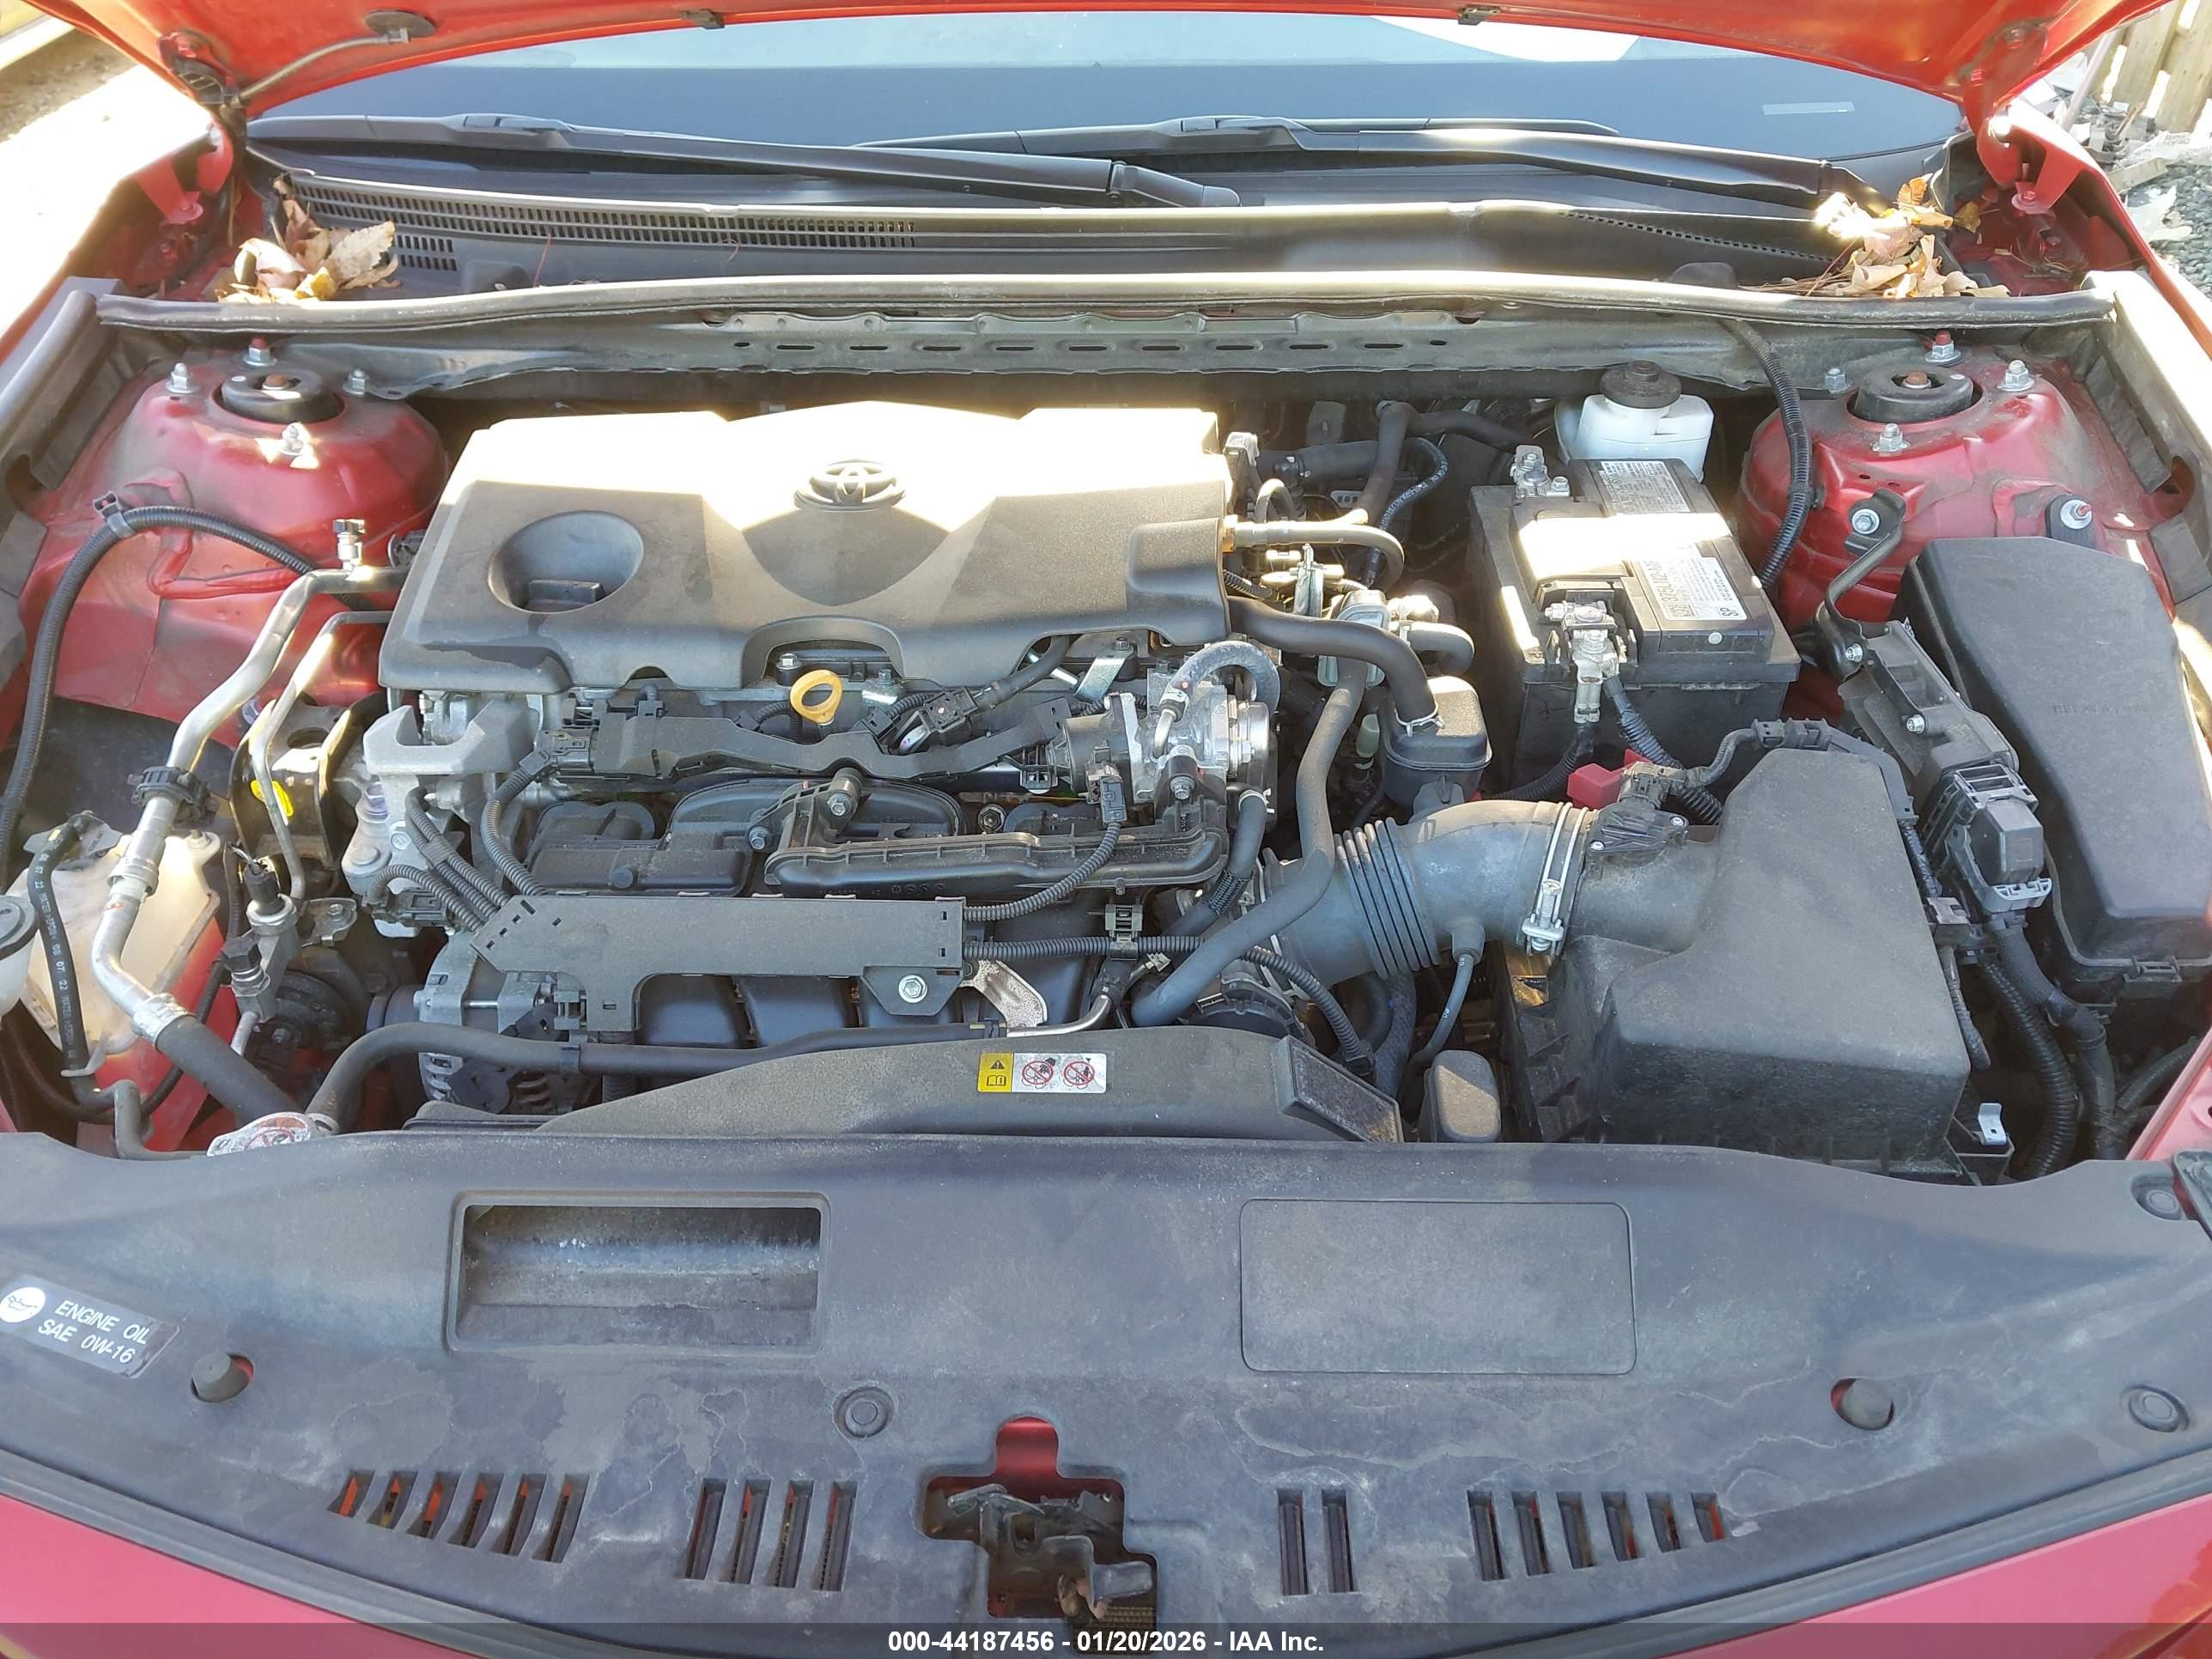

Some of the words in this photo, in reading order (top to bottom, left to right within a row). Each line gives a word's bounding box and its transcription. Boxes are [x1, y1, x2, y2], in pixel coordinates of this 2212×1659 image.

[1719, 607, 1739, 617] SP
[55, 960, 66, 972] 07
[58, 980, 69, 991] 22
[54, 1299, 120, 1333] ENGINE
[122, 1323, 152, 1346] OIL
[37, 1319, 78, 1343] SAE
[80, 1334, 137, 1364] 0W-16
